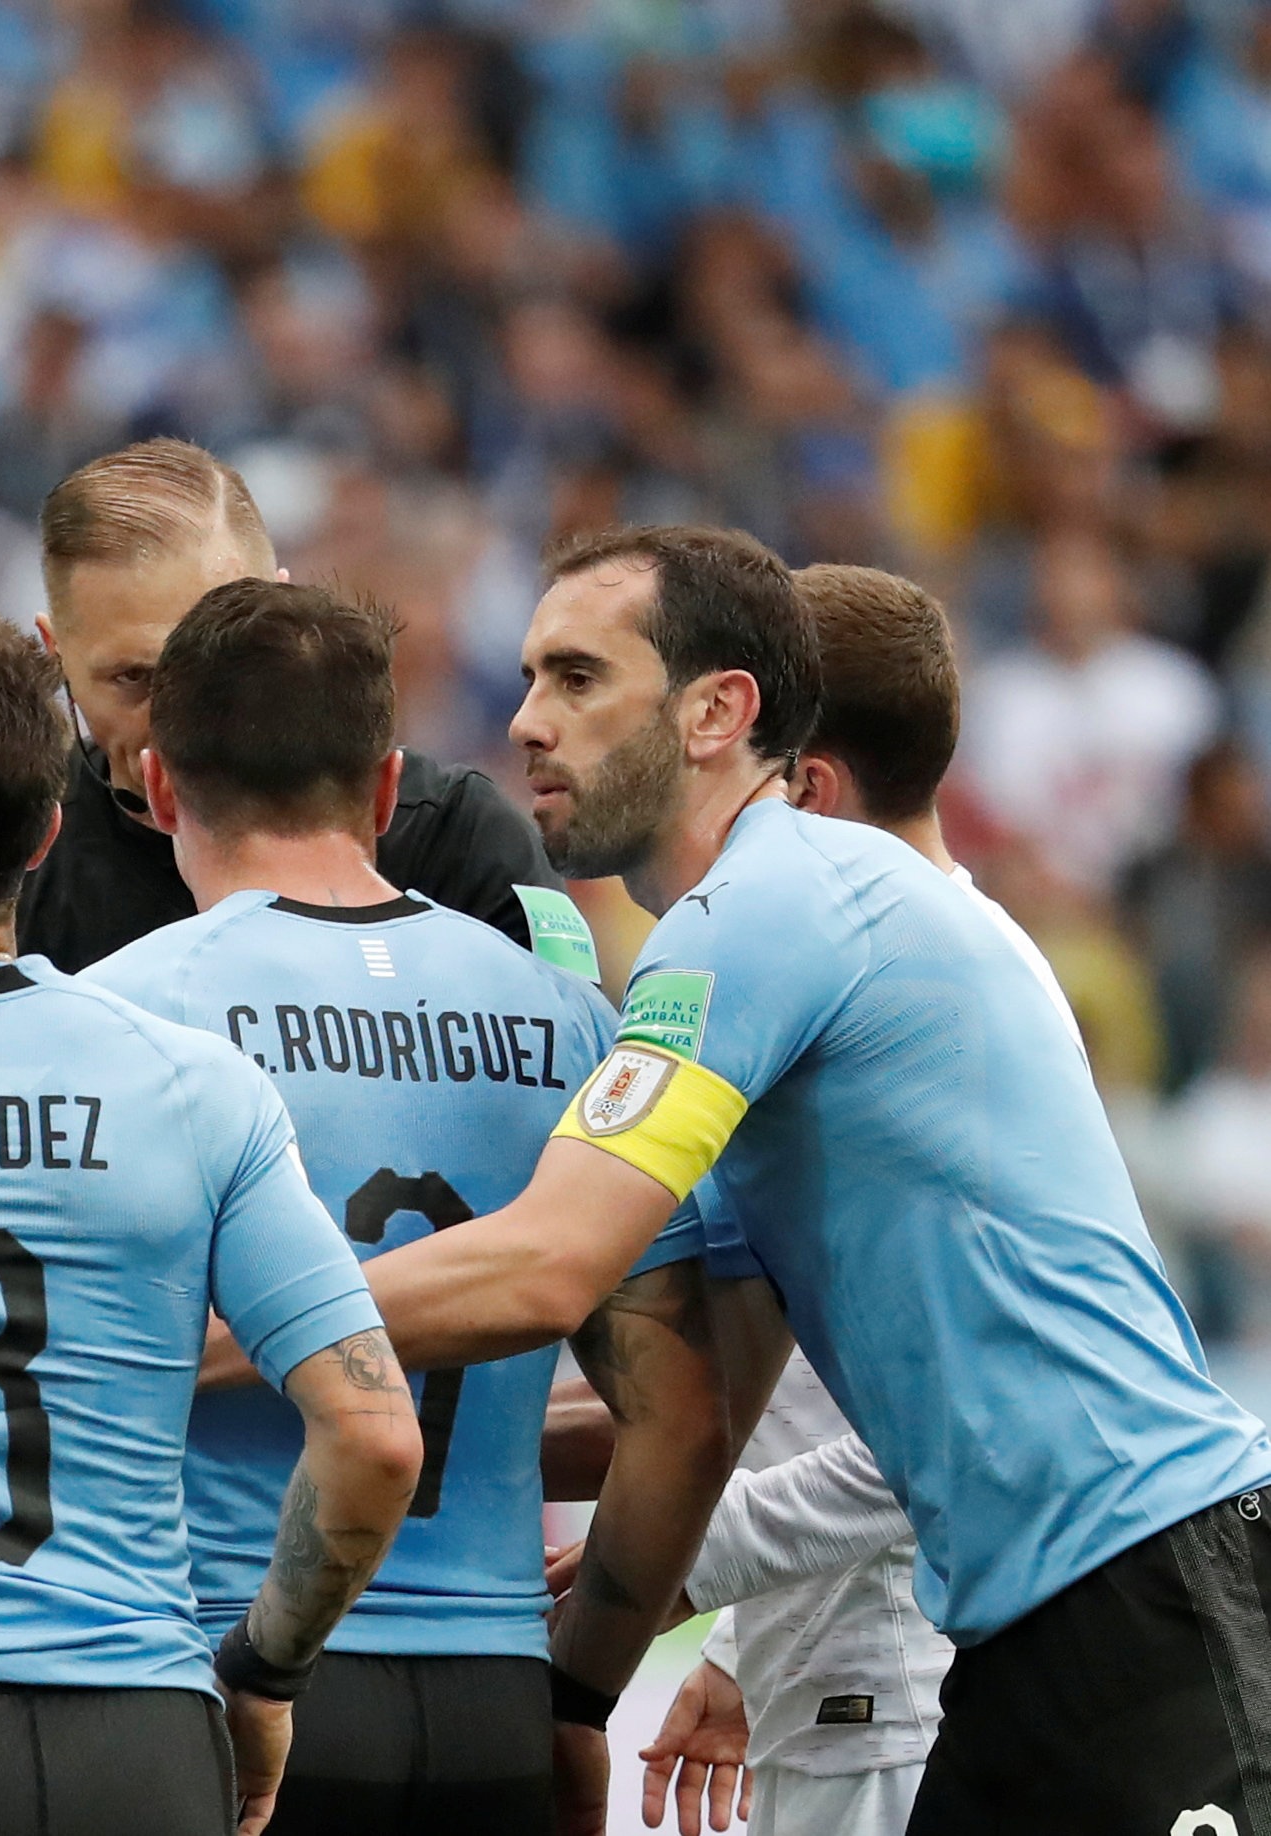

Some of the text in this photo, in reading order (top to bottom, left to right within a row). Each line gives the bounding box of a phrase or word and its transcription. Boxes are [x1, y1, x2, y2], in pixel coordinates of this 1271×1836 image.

[630, 1001, 699, 1014] LIVING
[632, 1011, 696, 1025] OOTBALL
[226, 999, 566, 1090] C.RODRÍGUEZ
[662, 1033, 692, 1047] FIFA
